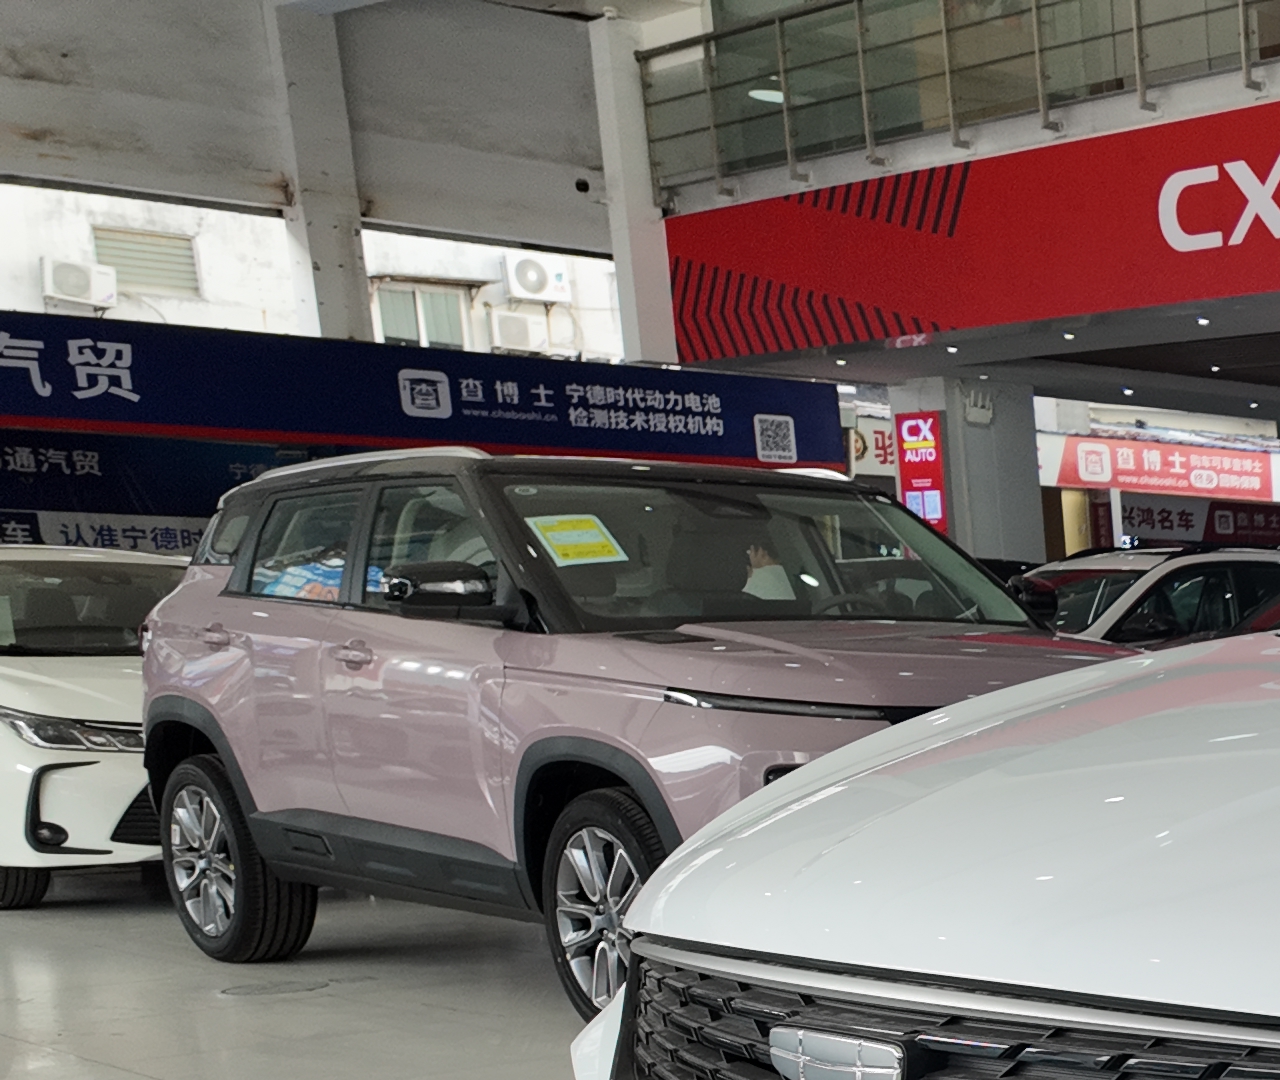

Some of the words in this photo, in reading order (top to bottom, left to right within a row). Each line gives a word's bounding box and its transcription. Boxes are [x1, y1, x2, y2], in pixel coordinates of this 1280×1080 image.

[458, 378, 555, 408] 查博士
[565, 383, 722, 414] 宁德时代动力电池
[568, 406, 724, 436] 检测技术授权机构
[901, 417, 935, 442] CX
[0, 446, 102, 477] 通汽贸
[904, 448, 937, 463] AUTO
